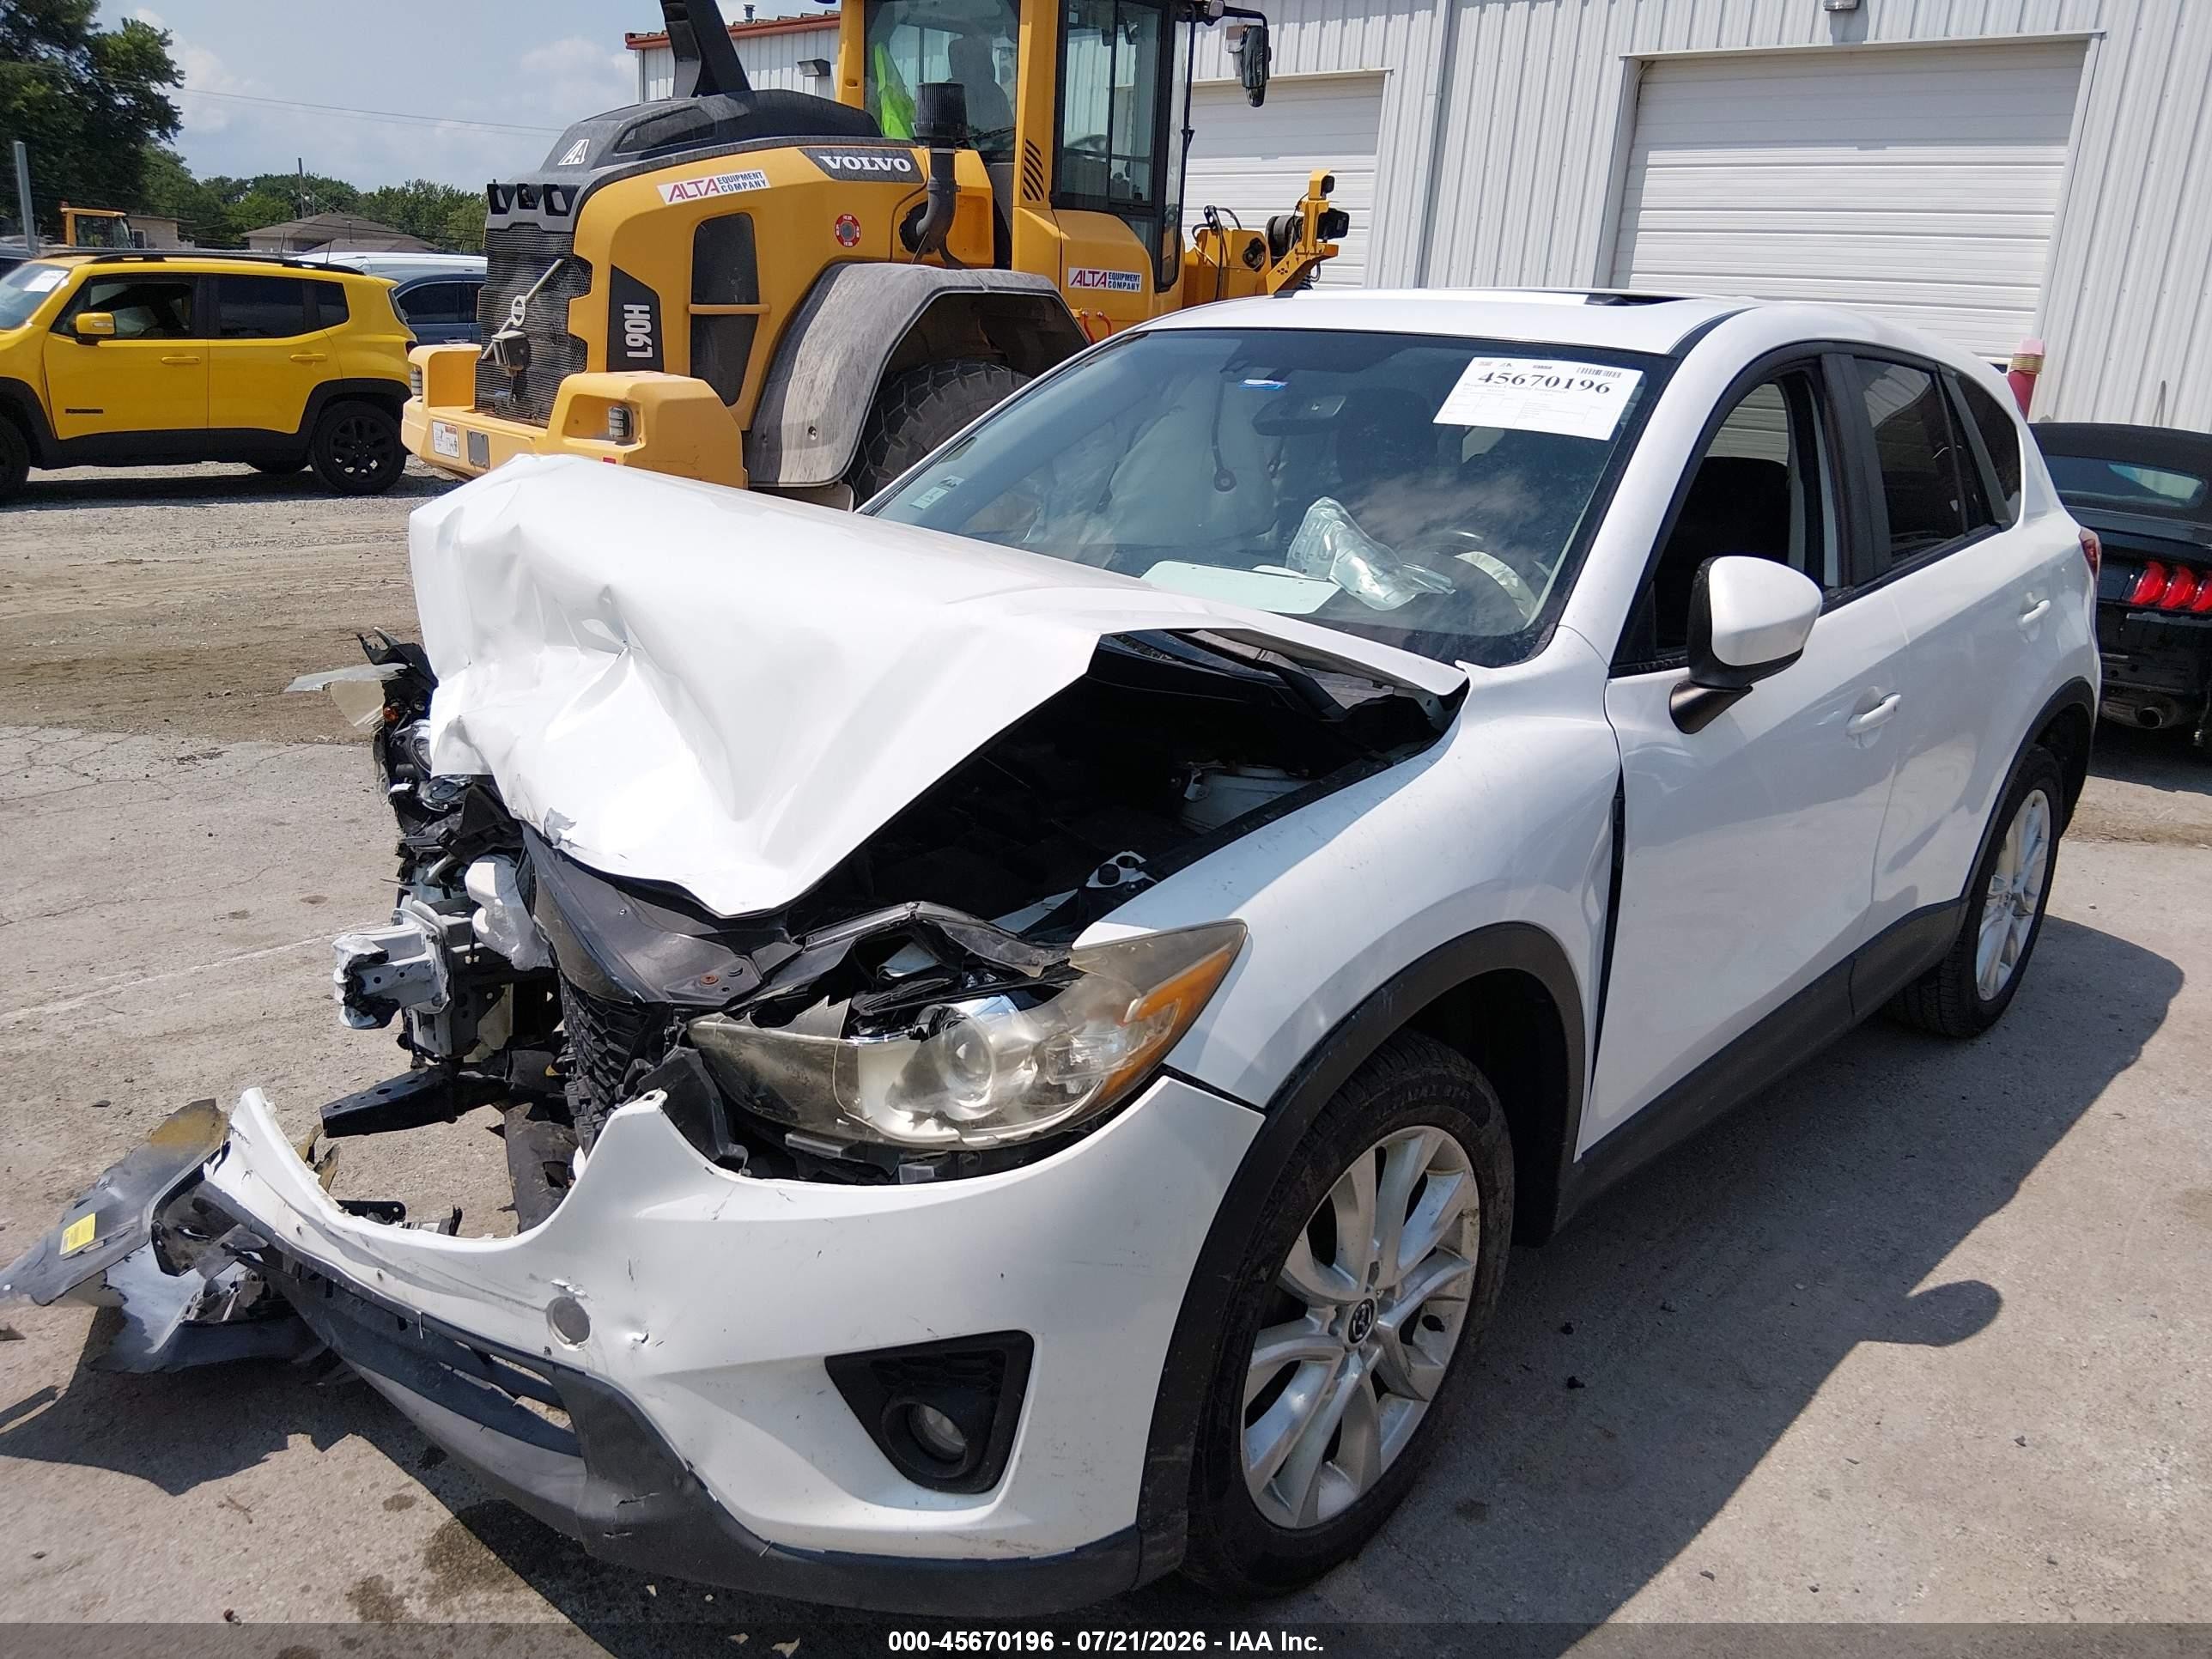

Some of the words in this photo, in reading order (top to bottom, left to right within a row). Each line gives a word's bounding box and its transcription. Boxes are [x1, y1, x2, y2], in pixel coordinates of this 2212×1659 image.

[818, 155, 912, 173] VOLVO
[716, 172, 763, 185] EQUIPMENT
[720, 179, 767, 193] COMPANY
[669, 178, 720, 203] ALTA
[1070, 270, 1108, 288] ALTA
[1108, 271, 1141, 283] EQUIPMENT
[1108, 281, 1140, 291] COMPANY
[623, 304, 653, 358] L90H
[1478, 372, 1614, 394] 45670196
